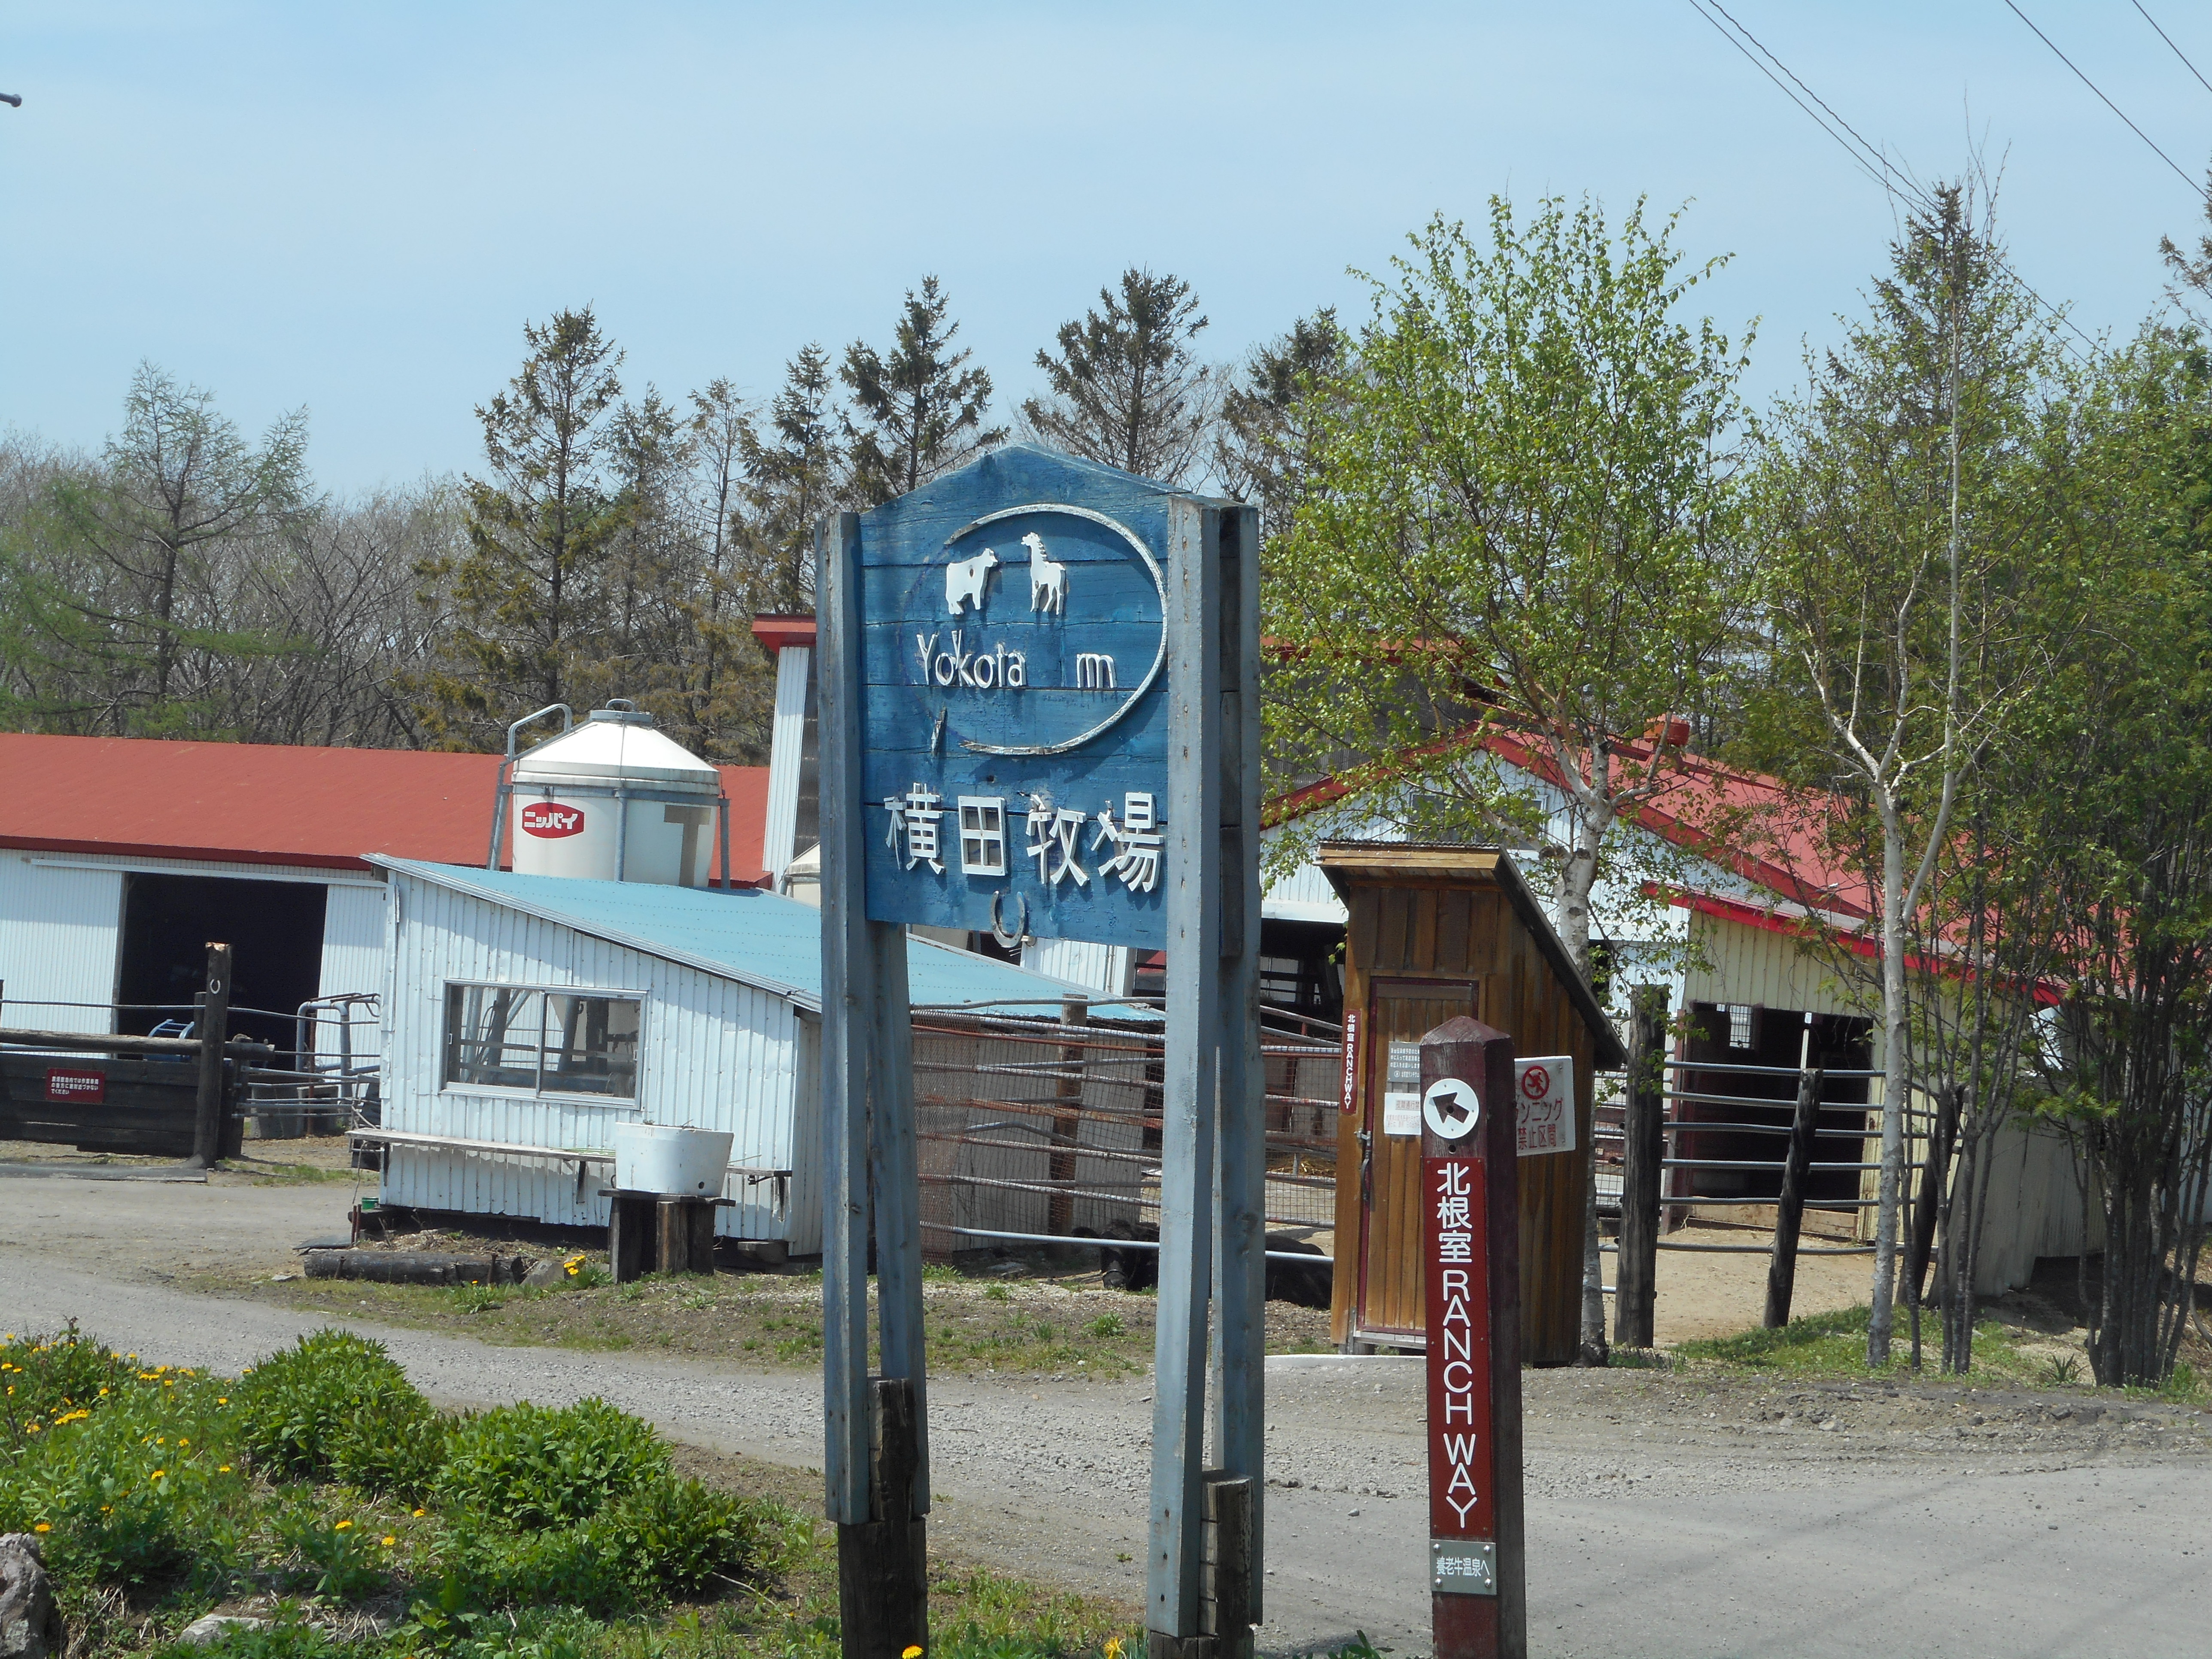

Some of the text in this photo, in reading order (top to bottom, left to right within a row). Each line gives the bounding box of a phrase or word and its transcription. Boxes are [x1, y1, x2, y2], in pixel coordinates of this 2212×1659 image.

[916, 629, 1027, 688] Yokota
[524, 811, 578, 830] ニッパイ
[883, 782, 1164, 893] 横田牧場
[1347, 1014, 1355, 1042] 北根室
[1516, 1097, 1563, 1124] ンニング
[1518, 1124, 1556, 1150] 禁止区間
[1437, 1162, 1473, 1263] 北根室
[1437, 1556, 1490, 1577] 養老牛温泉へ
